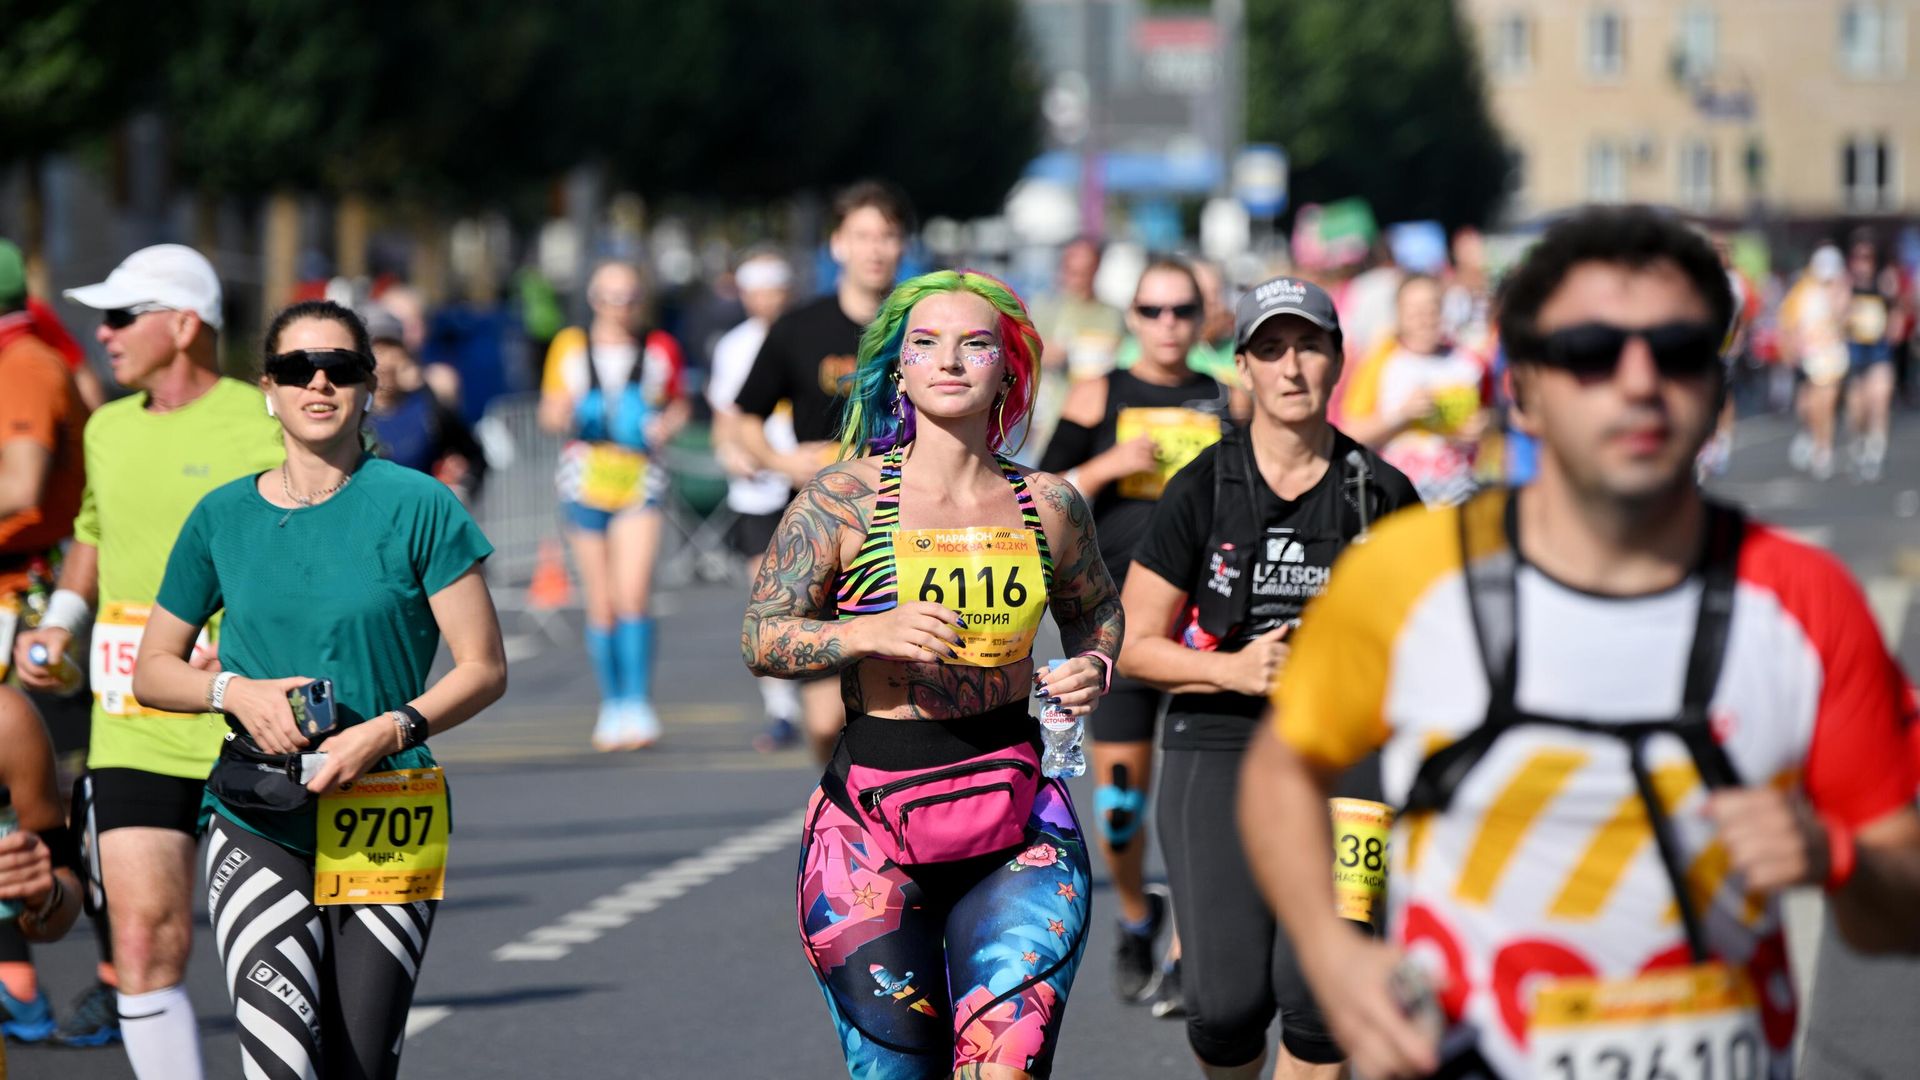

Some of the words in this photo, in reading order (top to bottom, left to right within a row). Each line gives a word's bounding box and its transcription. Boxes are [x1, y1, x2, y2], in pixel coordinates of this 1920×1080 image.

[936, 532, 992, 543] МАРАФОН
[937, 543, 985, 552] МОСКВА
[919, 566, 1027, 608] 6116
[334, 806, 433, 847] 9707
[368, 852, 404, 863] ИННА
[330, 874, 340, 897] J
